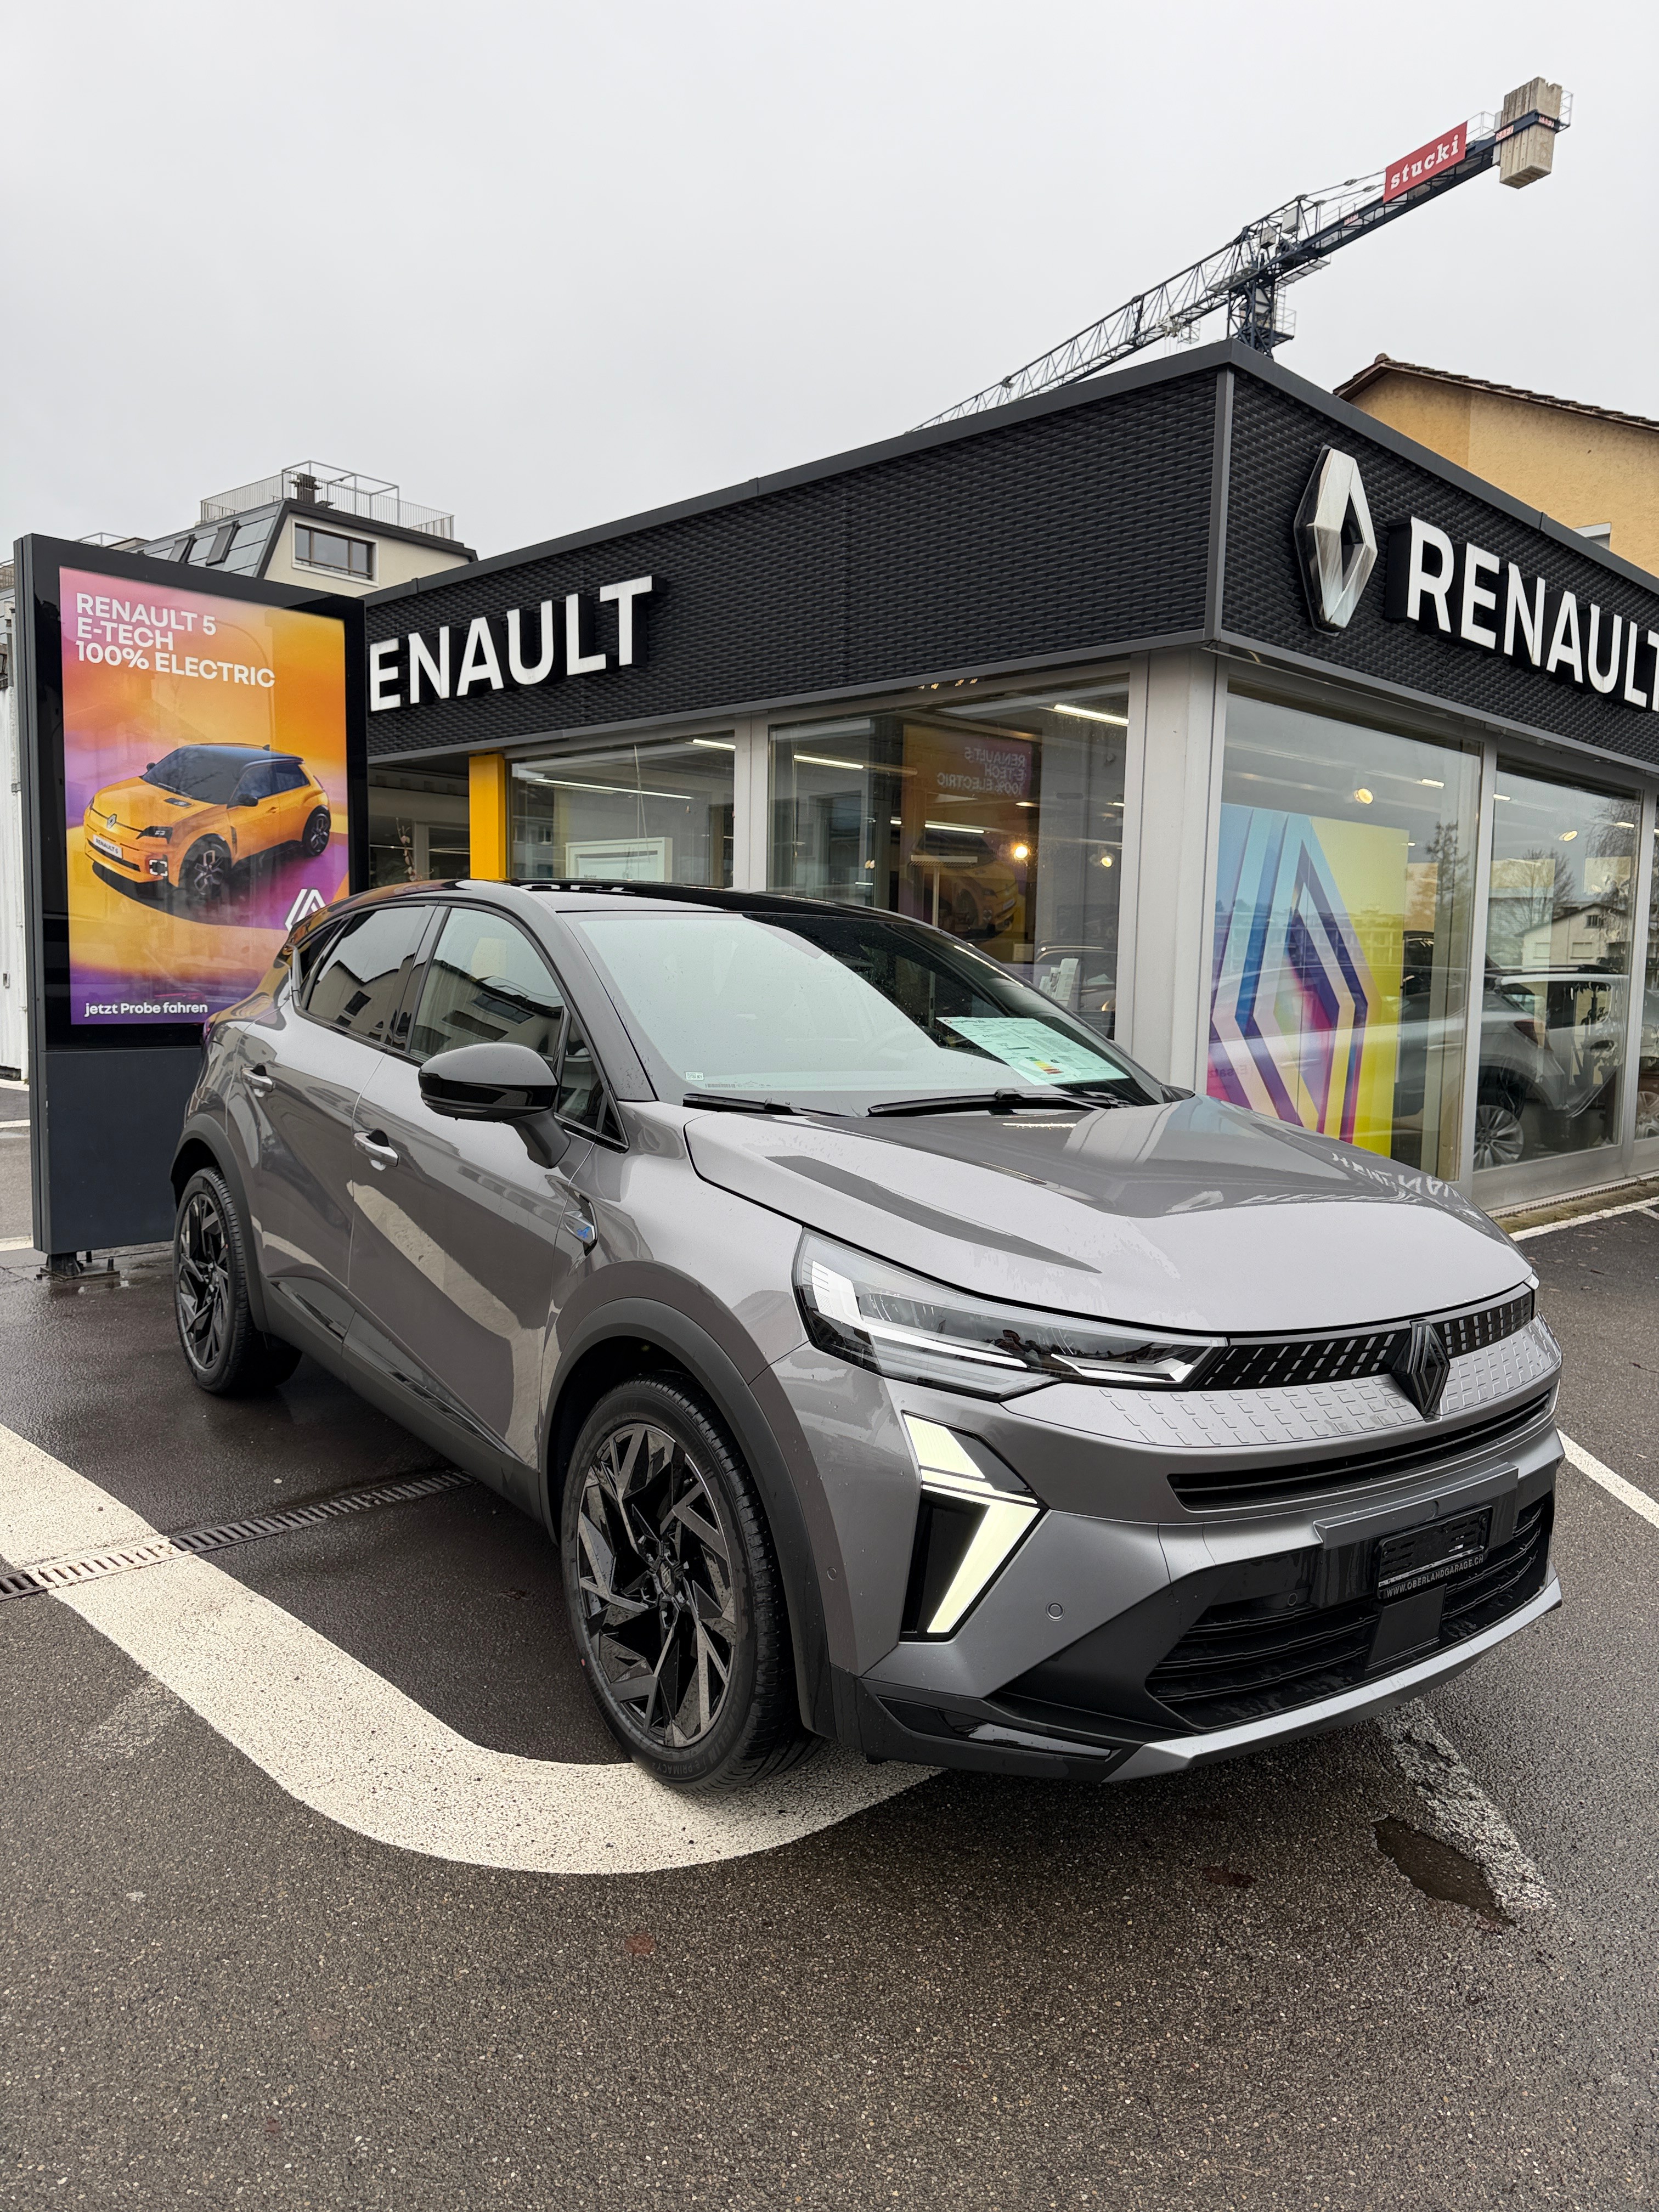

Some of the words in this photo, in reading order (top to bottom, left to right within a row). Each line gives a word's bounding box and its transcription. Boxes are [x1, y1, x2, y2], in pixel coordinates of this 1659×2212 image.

[1390, 134, 1459, 190] stucki
[76, 592, 198, 632] RENAULT
[202, 616, 217, 635] 5
[76, 616, 174, 651] E-TECH
[75, 640, 150, 670] 100%
[155, 651, 275, 688] ELECTRIC
[369, 575, 652, 712] ENAULT
[84, 1002, 119, 1018] jetzt
[121, 1003, 161, 1014] Probe
[163, 1002, 208, 1014] fahren
[1386, 1554, 1485, 1598] WWW.OBERLANDGARAGE.CH
